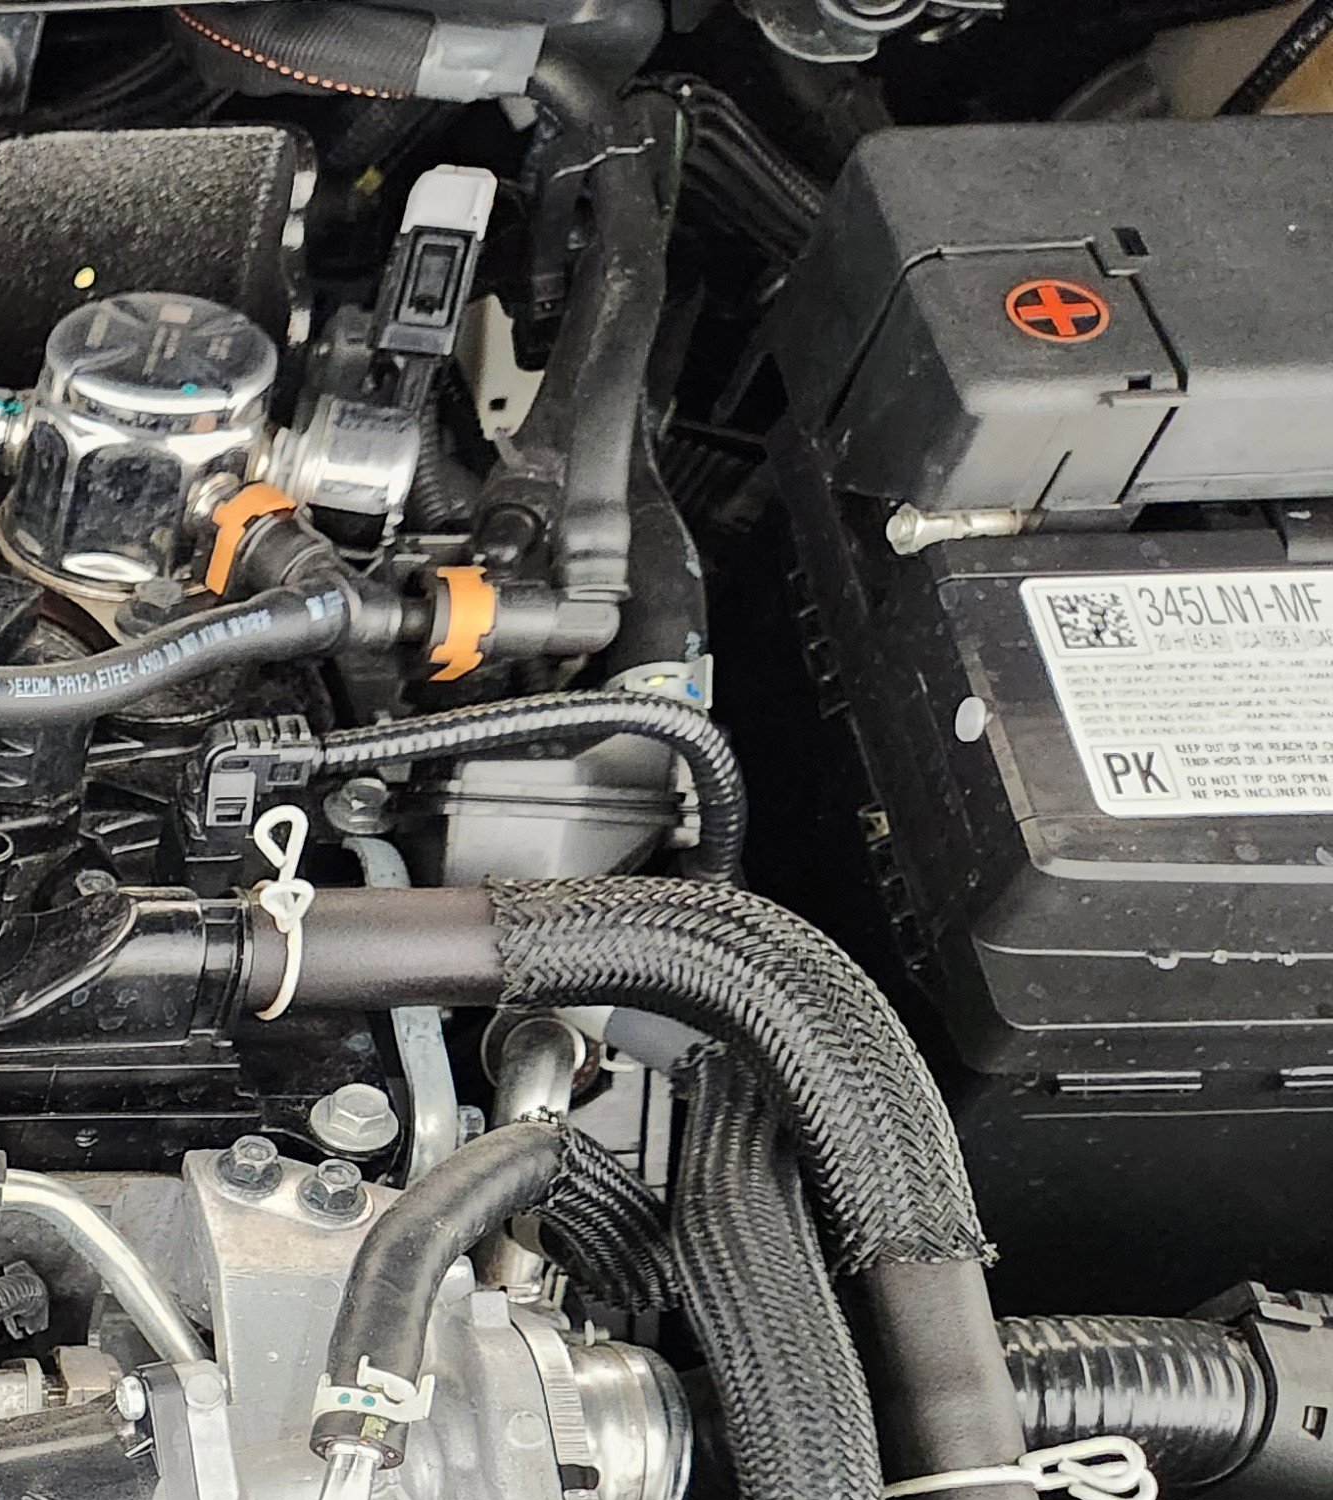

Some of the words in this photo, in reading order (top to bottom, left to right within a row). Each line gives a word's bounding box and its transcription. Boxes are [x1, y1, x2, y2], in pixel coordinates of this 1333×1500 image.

[1137, 582, 1322, 626] 345LN1-MF
[1103, 752, 1169, 795] PK
[1185, 775, 1207, 786] DO
[1209, 774, 1238, 785] NOT
[1213, 788, 1241, 798] PAS
